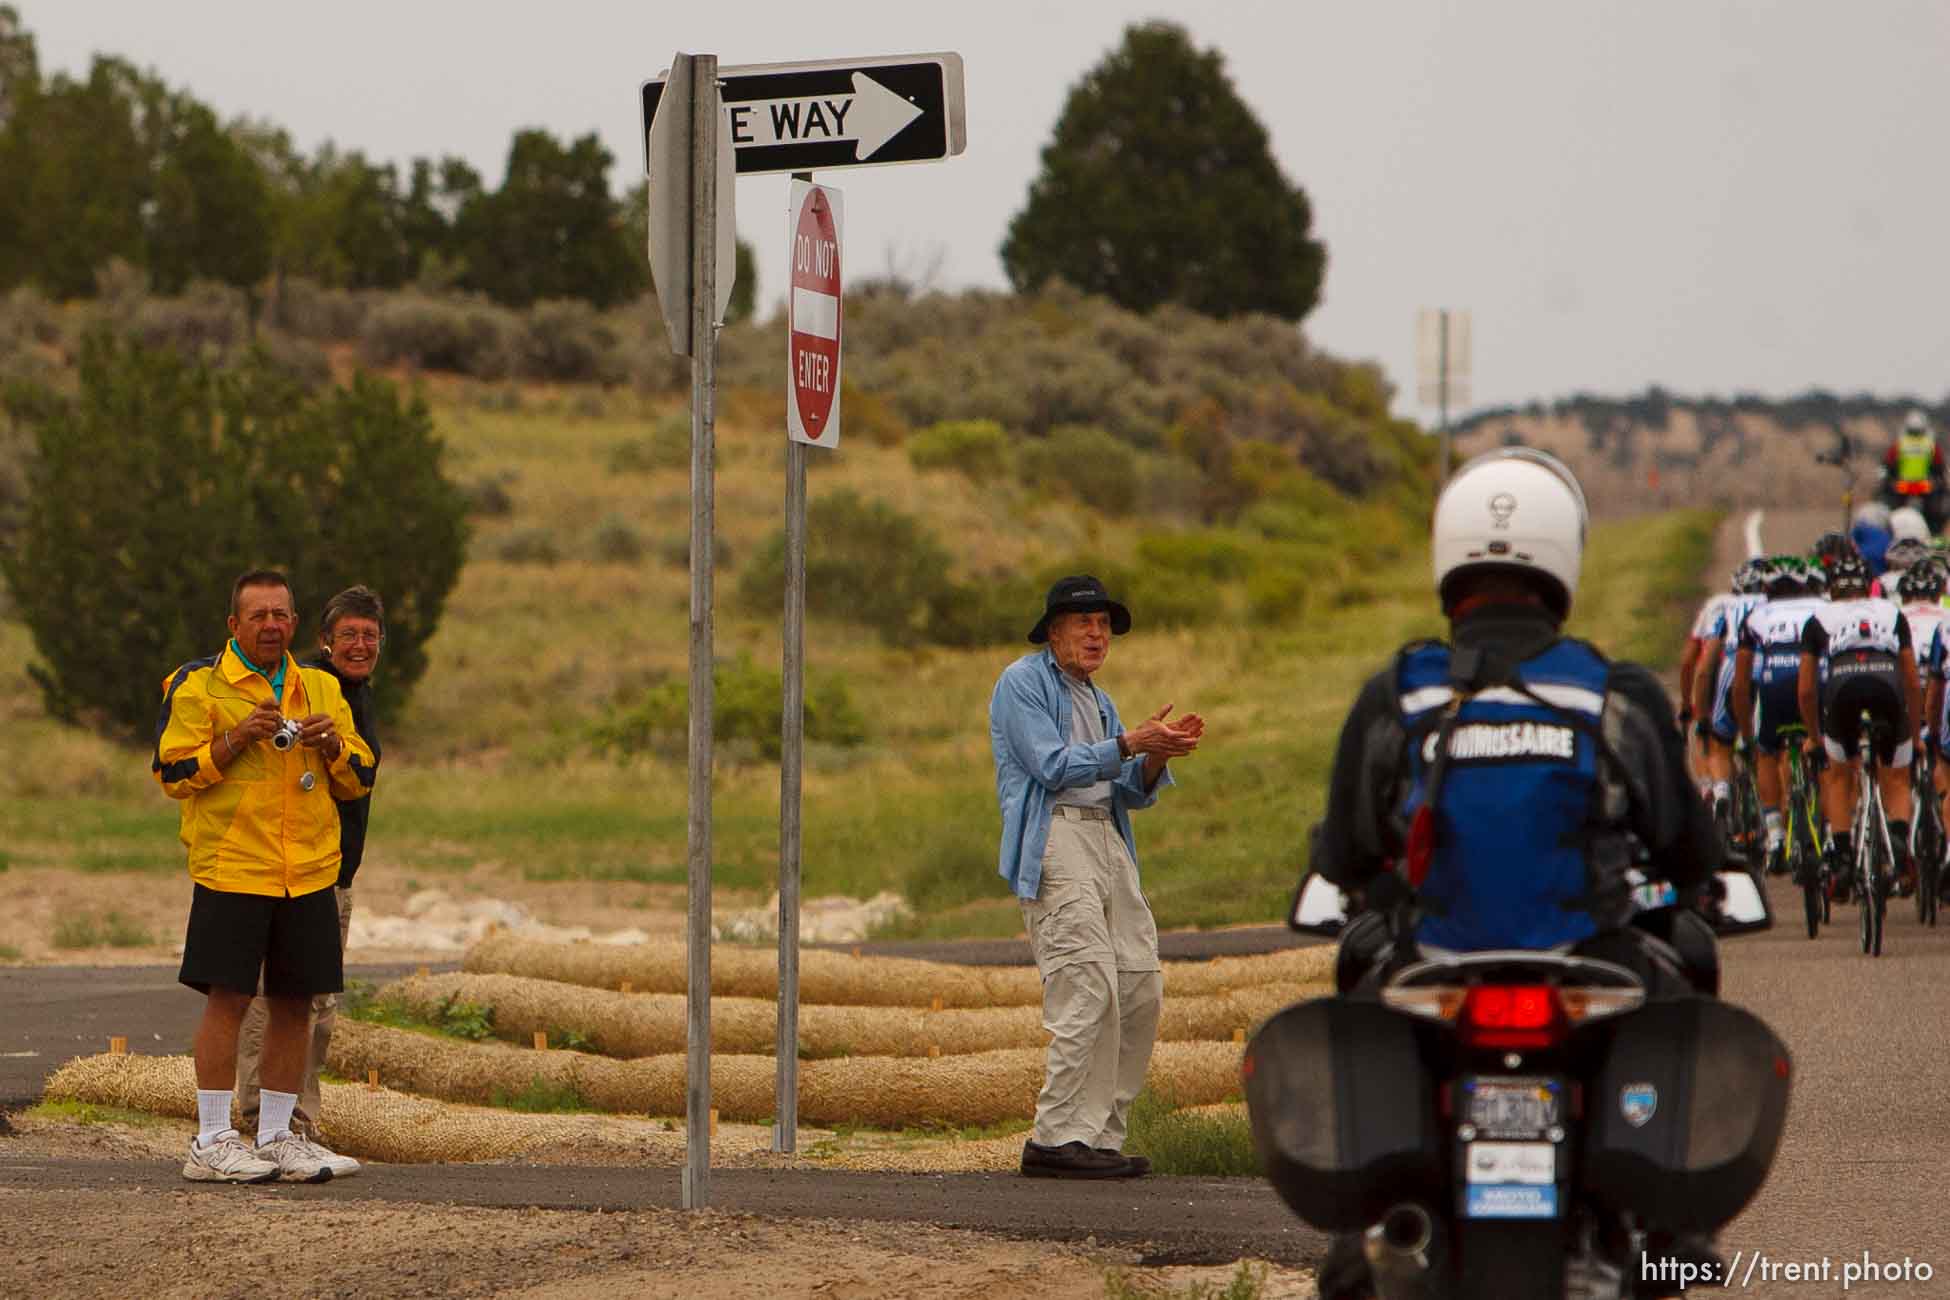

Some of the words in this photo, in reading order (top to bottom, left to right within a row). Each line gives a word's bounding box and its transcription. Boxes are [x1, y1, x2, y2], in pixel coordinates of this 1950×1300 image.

[769, 99, 854, 141] WAY
[797, 233, 811, 274] DO
[815, 239, 836, 281] NOT
[798, 350, 830, 393] ENTER
[1421, 722, 1574, 762] CMMISSAIRE
